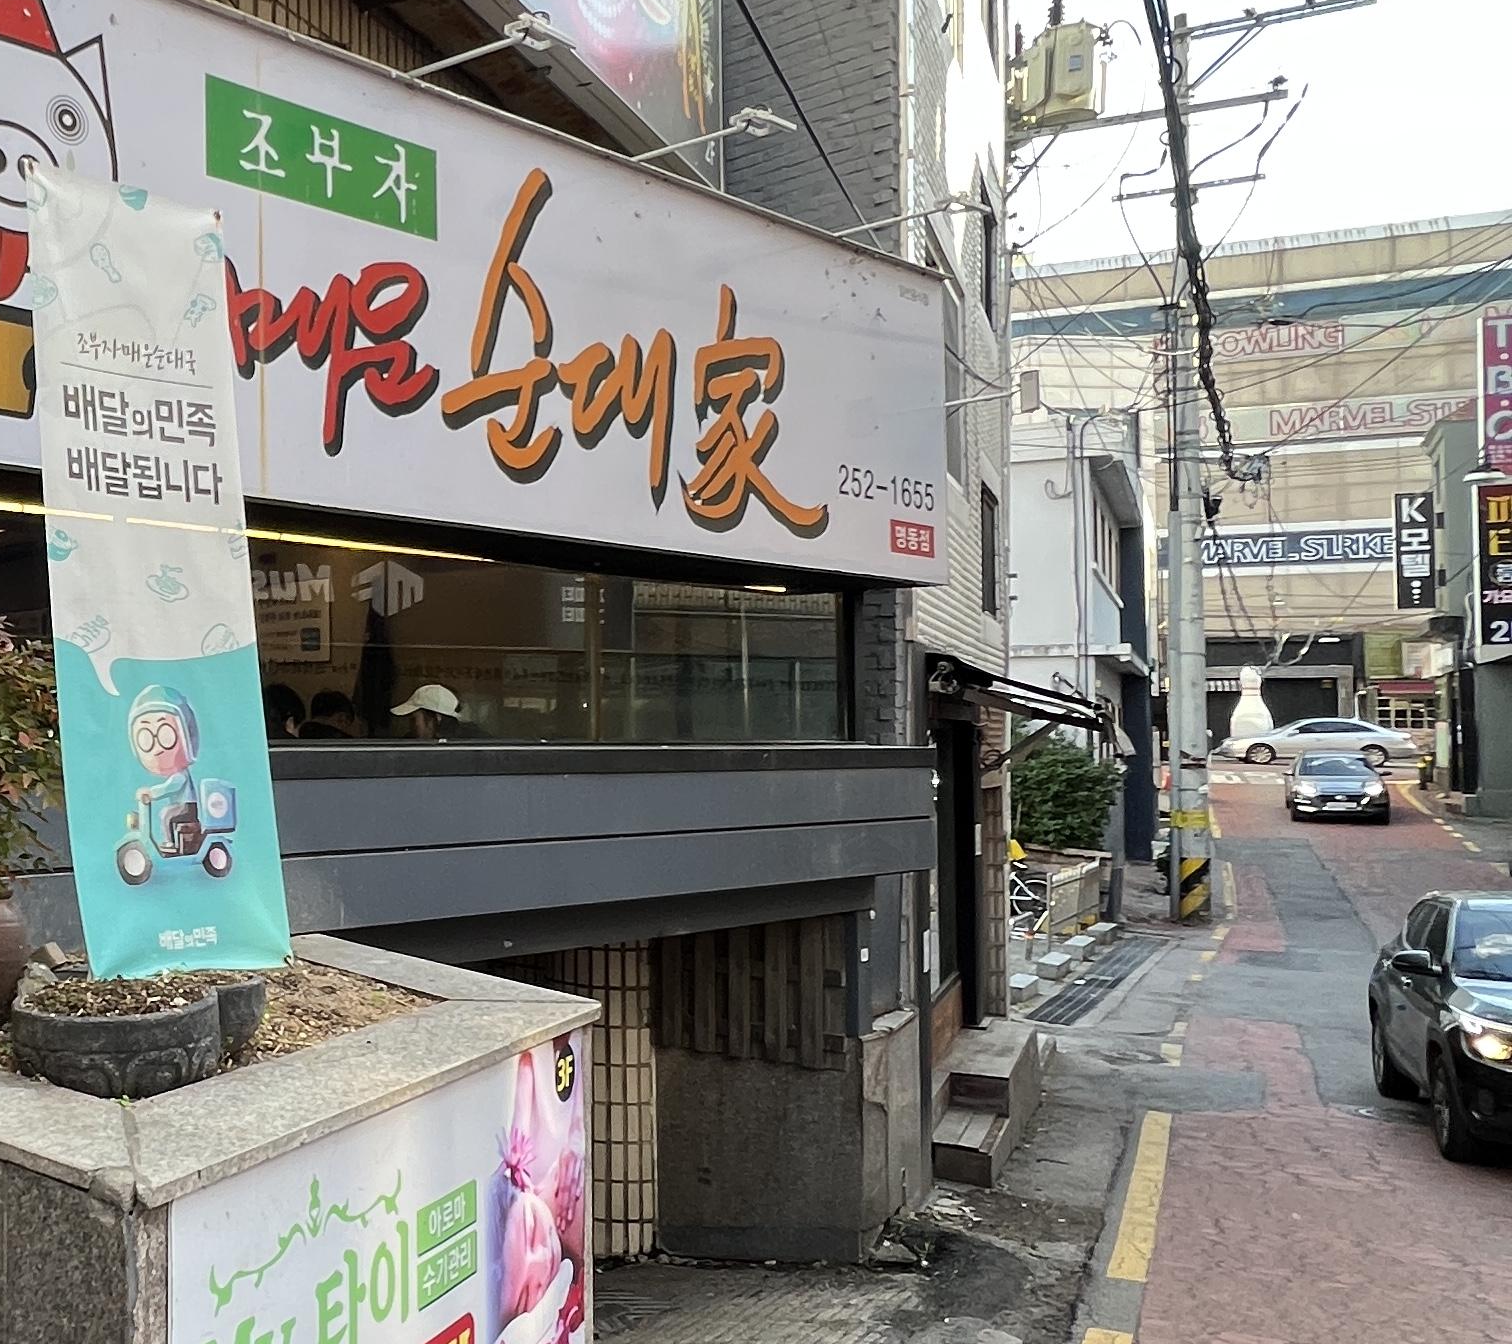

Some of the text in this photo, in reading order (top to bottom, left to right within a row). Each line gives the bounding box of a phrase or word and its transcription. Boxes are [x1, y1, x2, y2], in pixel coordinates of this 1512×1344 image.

[240, 110, 418, 224] 조부자
[62, 383, 217, 448] 배달의민족
[66, 446, 223, 506] 배달됩니다
[838, 463, 935, 512] 252-1655
[894, 525, 931, 554] 명동점
[557, 1054, 574, 1092] 3F
[429, 1192, 466, 1236] 아로마
[423, 1239, 472, 1296] 수기관리
